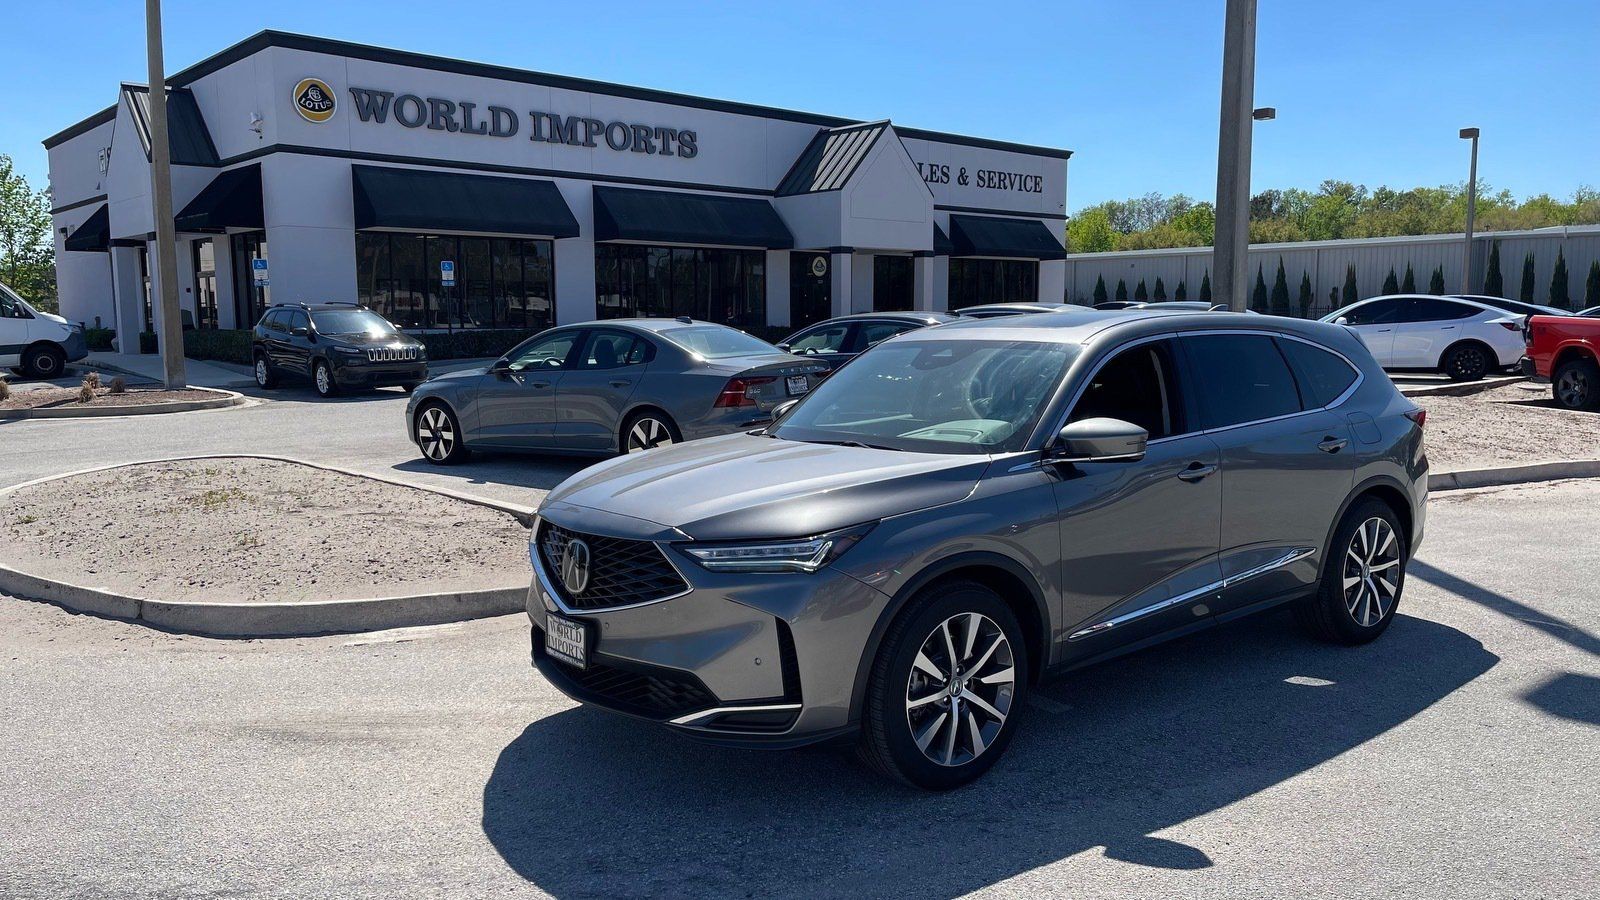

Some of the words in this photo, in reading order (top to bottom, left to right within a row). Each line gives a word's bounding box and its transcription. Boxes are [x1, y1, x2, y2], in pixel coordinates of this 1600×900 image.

[300, 97, 332, 110] LOTUS
[349, 87, 519, 138] WORLD
[529, 111, 699, 159] IMPORTS
[917, 162, 950, 185] LES
[957, 166, 970, 186] &
[976, 169, 1043, 193] SERVICE
[549, 619, 582, 644] WORLD
[548, 634, 585, 661] IMPORTS
